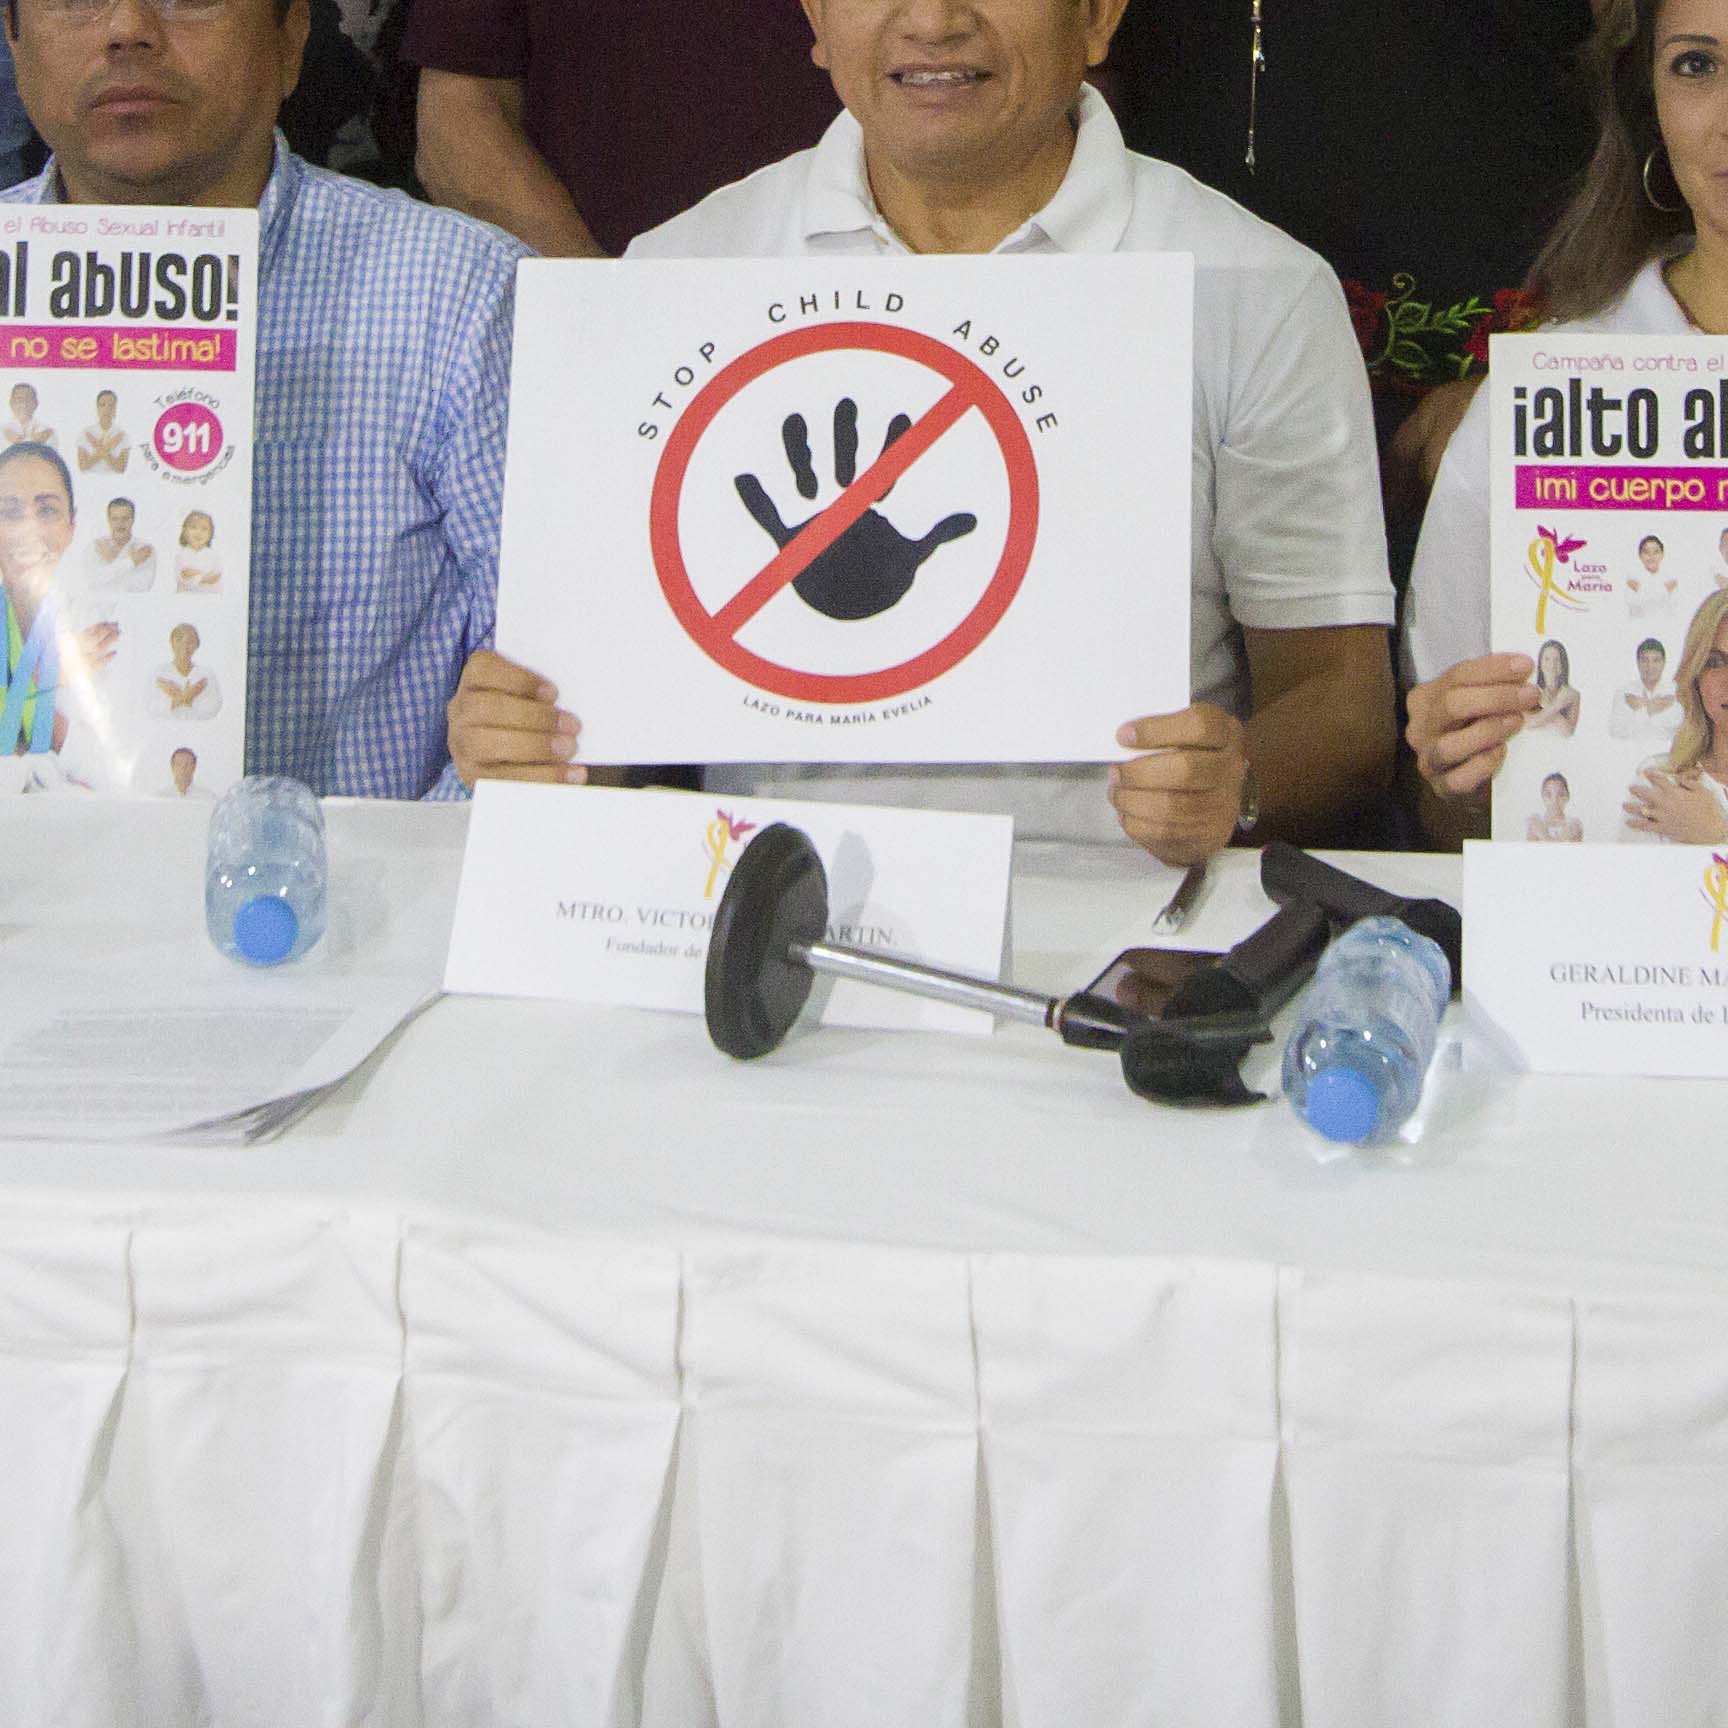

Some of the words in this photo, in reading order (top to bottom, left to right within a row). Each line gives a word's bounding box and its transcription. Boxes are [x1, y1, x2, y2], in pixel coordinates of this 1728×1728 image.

[5, 215, 22, 233] el
[30, 215, 87, 235] Abuso
[97, 217, 159, 237] Sexual
[167, 218, 225, 238] Infantil
[49, 249, 240, 321] abuso!
[10, 335, 48, 359] no
[61, 336, 97, 360] se
[112, 332, 221, 362] lastima!
[638, 340, 718, 441] STOP
[768, 289, 906, 324] CHILD
[953, 319, 1060, 434] ABUSE
[1532, 351, 1624, 373] Campaña
[1633, 355, 1697, 372] contra
[1706, 353, 1724, 372] el
[1514, 378, 1659, 459] ¡alto
[162, 421, 211, 454] 911
[1589, 475, 1706, 507] cuerpo
[605, 935, 679, 957] Fundador
[683, 941, 703, 959] de
[825, 924, 897, 945] ARTIN.
[1549, 962, 1691, 986] GERALDINE
[1580, 1000, 1685, 1023] Presidenta
[1691, 1003, 1714, 1024] de
